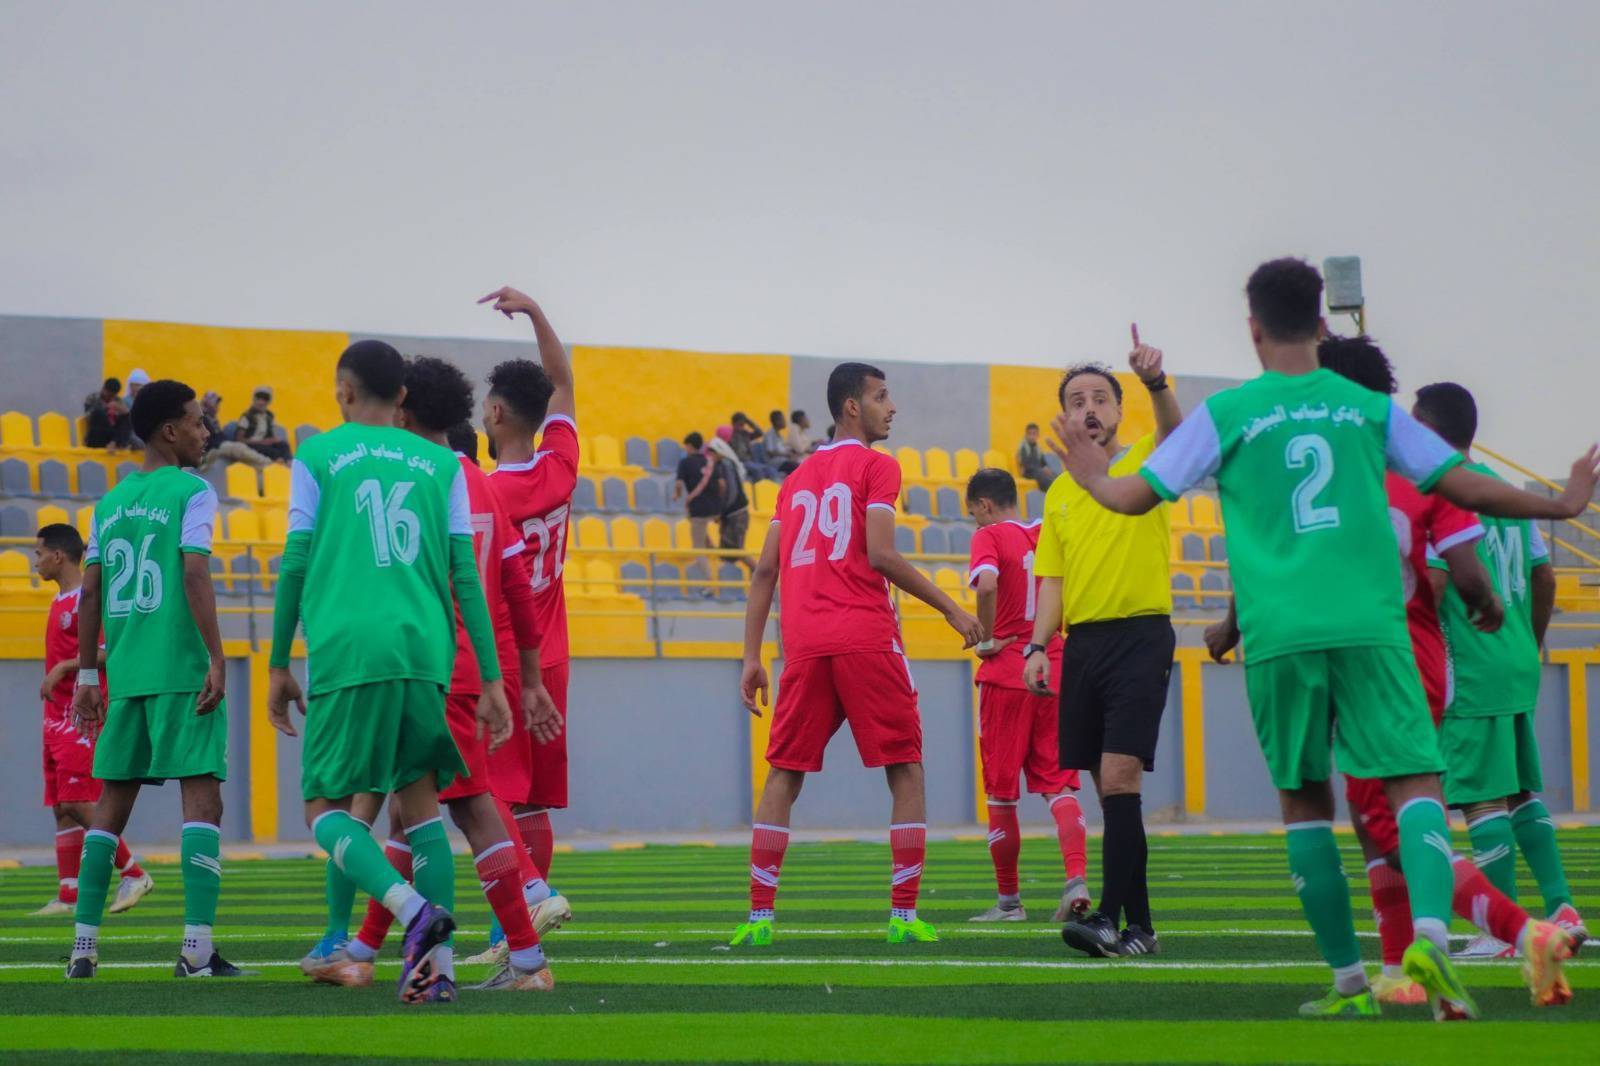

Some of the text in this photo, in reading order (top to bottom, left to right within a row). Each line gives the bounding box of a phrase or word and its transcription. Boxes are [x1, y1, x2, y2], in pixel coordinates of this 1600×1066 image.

[328, 442, 436, 477] نادي شباب البيضاء
[1285, 433, 1340, 534] 2
[354, 479, 421, 568] 16
[522, 503, 570, 593] 27
[790, 482, 852, 568] 29
[1484, 525, 1527, 607] 14
[104, 533, 163, 618] 26
